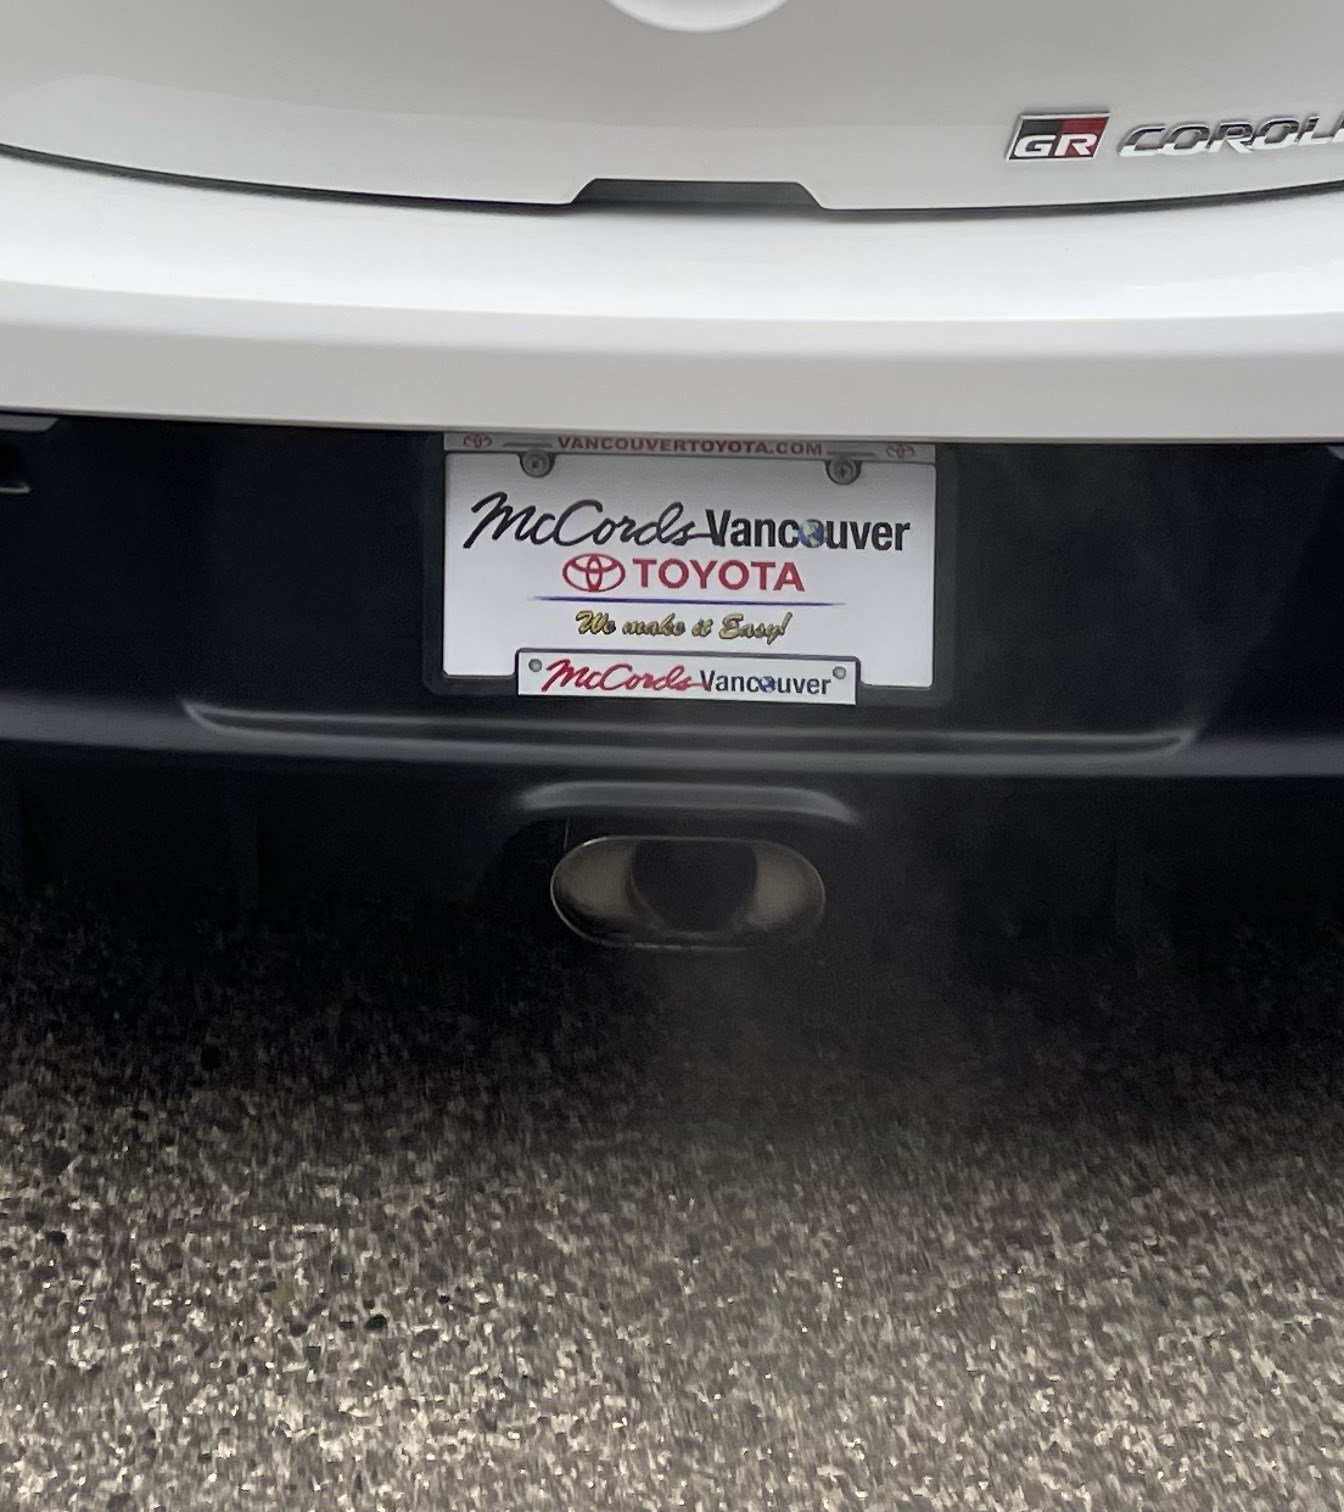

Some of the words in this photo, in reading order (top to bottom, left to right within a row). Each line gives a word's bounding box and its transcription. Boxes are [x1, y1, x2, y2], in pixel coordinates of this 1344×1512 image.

[1013, 132, 1099, 158] GR
[557, 435, 823, 456] VANCOUVERTOYOTA.COM
[632, 557, 806, 593] TOYOTA
[575, 610, 617, 635] We
[621, 613, 686, 637] make
[691, 617, 715, 638] it
[718, 611, 794, 645] Easy!
